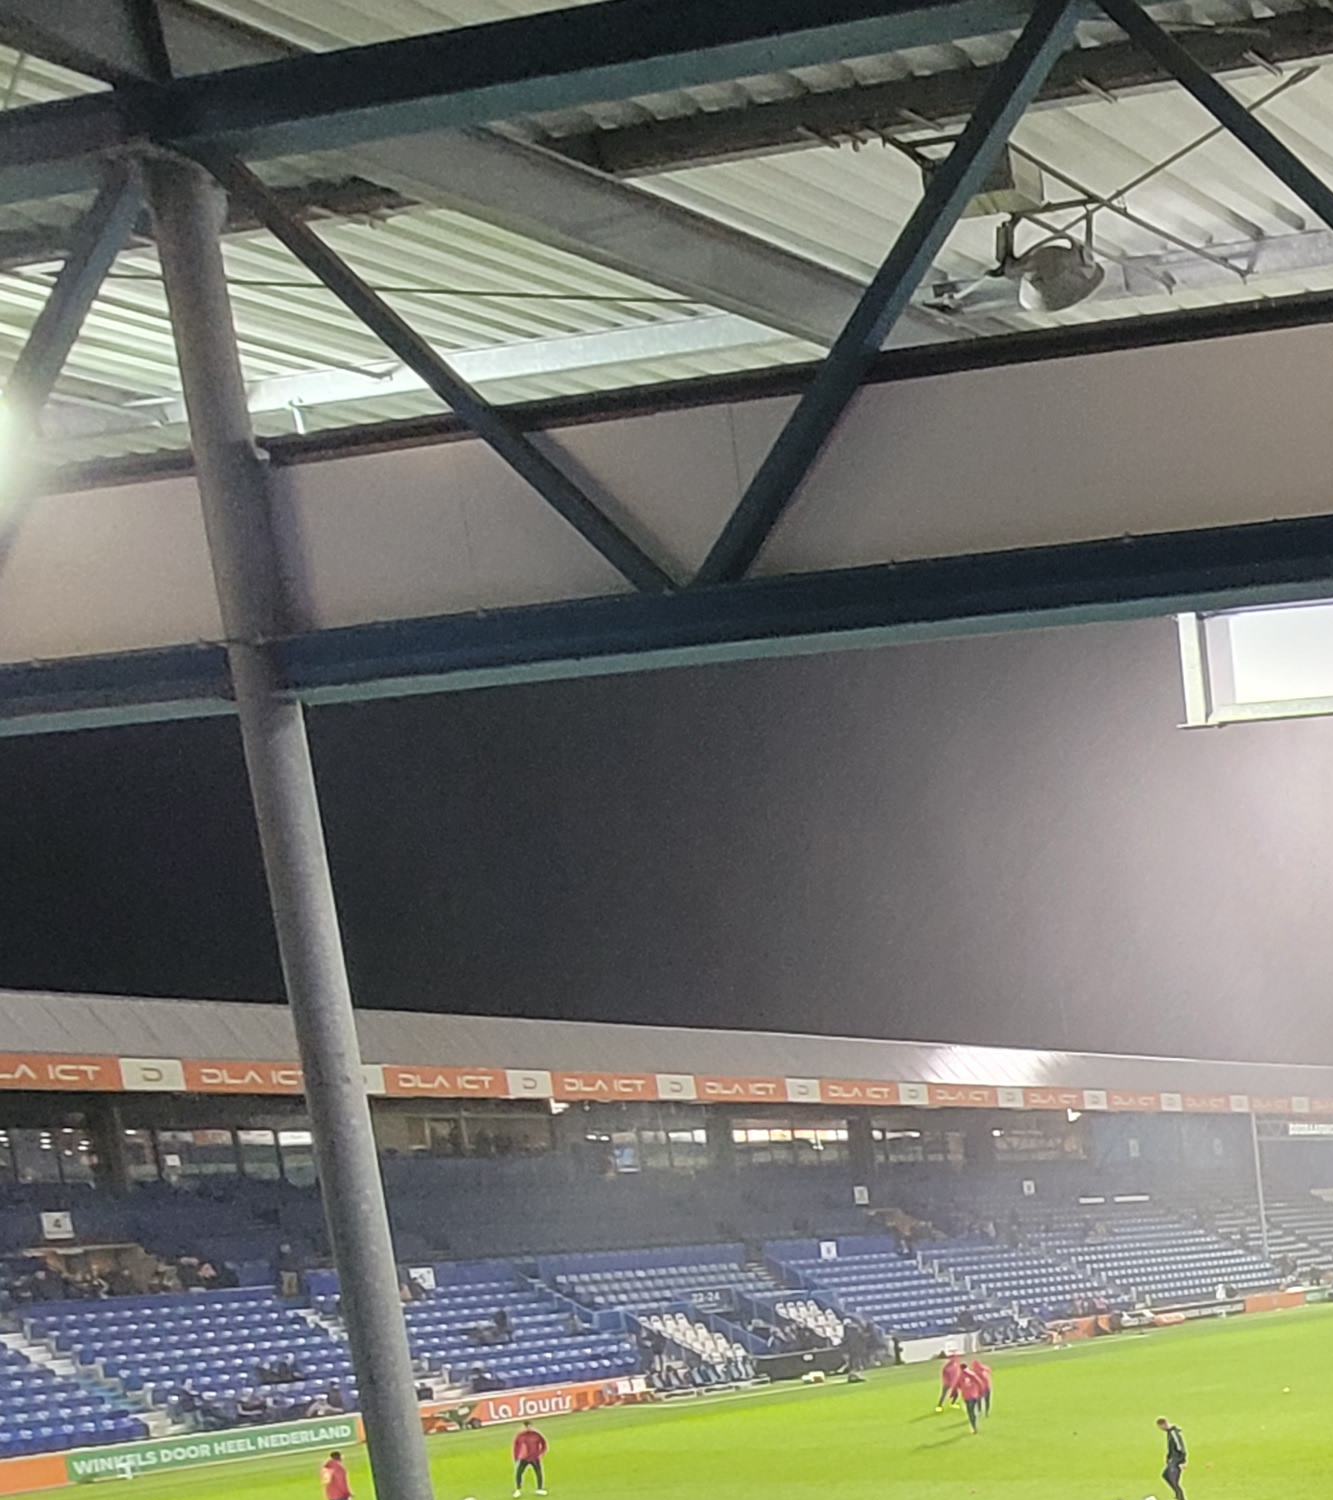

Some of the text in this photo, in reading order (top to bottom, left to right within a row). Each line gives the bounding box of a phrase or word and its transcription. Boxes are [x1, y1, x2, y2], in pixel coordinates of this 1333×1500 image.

[48, 1064, 101, 1081] ICT
[201, 1068, 303, 1085] DLA IC
[398, 1073, 494, 1090] DLA ICT
[563, 1077, 646, 1092] DLA ICT
[705, 1082, 777, 1095] DLA ICT
[828, 1085, 891, 1098] DLA ICT
[489, 1389, 573, 1420] La Souris
[72, 1424, 352, 1476] WINKELS DOOR HEEL NEDERLAND
